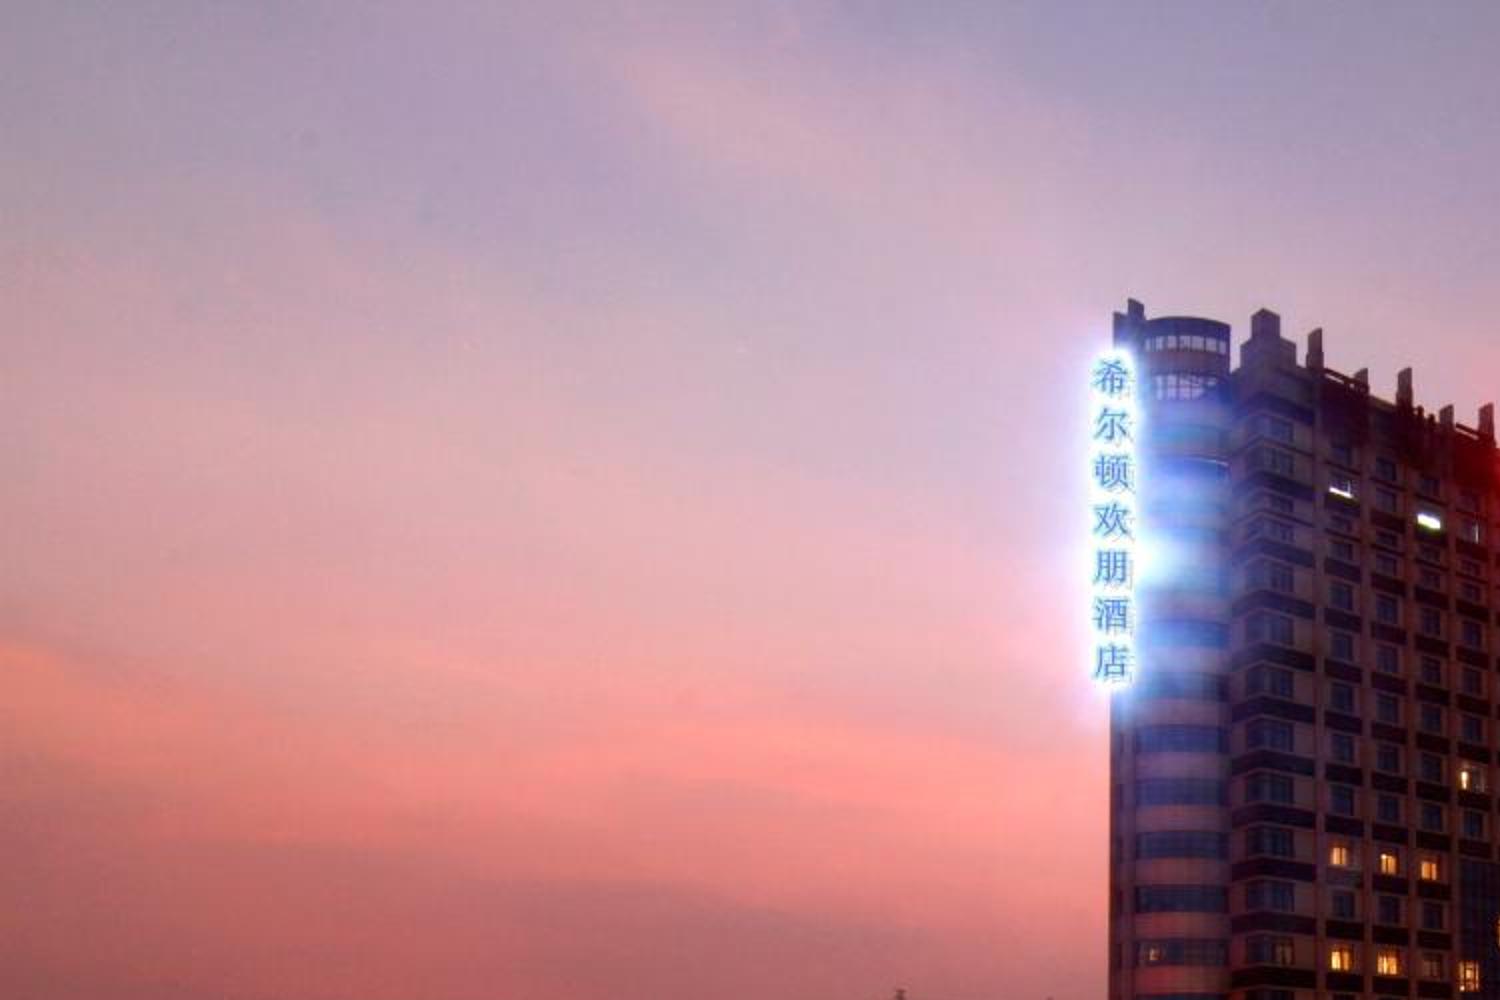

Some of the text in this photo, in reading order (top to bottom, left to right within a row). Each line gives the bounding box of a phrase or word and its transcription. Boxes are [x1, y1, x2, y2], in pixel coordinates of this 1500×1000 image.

[1093, 358, 1129, 681] 希尔顿欢朋酒店
